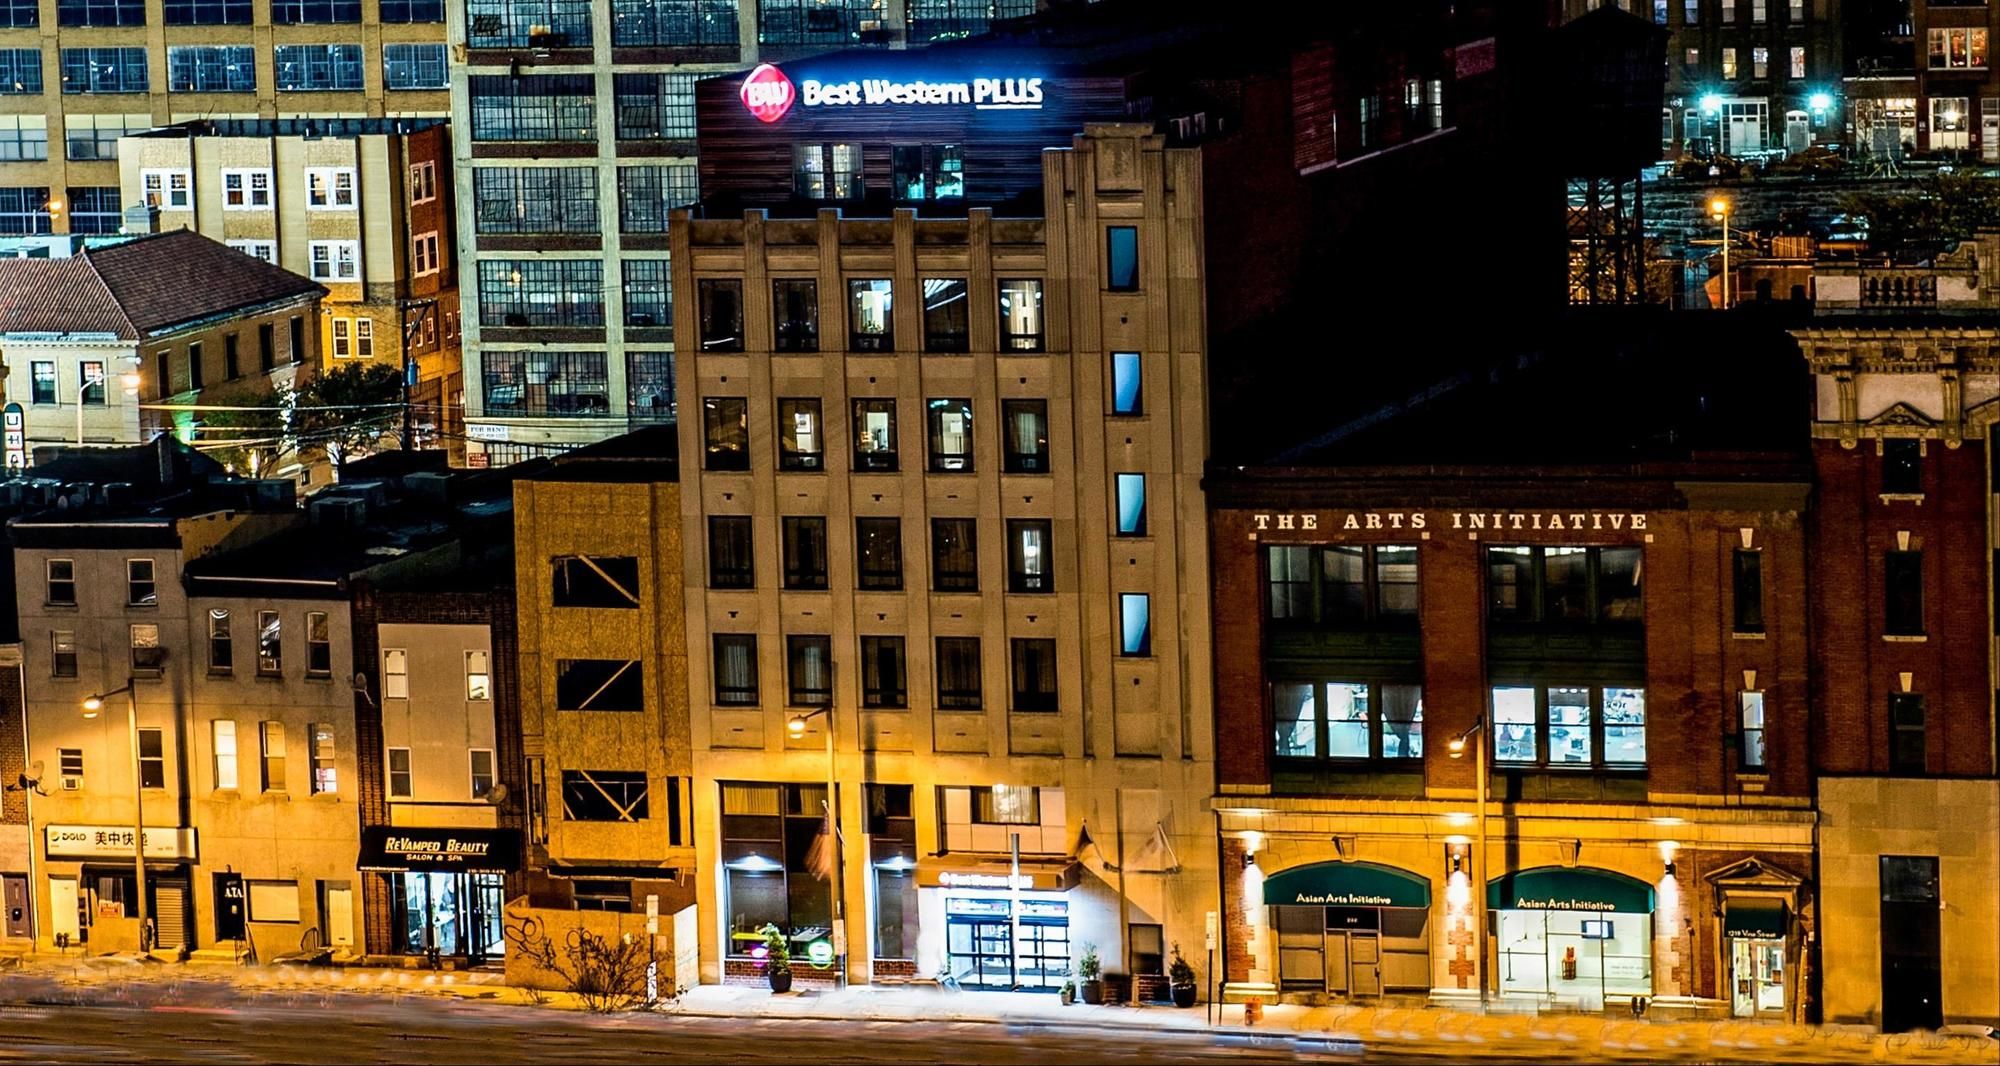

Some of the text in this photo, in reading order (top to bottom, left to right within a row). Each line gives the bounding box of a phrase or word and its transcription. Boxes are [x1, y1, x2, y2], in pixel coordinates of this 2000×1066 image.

[803, 78, 1043, 106] Best Western PLUS
[1254, 513, 1647, 530] THE ARTS INITIATIVE
[406, 853, 433, 861] SALON
[1296, 893, 1391, 904] Asian Arts Initiative
[1517, 897, 1615, 910] Asian Arts Initiative
[1741, 929, 1756, 937] Vine
[1756, 929, 1776, 937] Street
